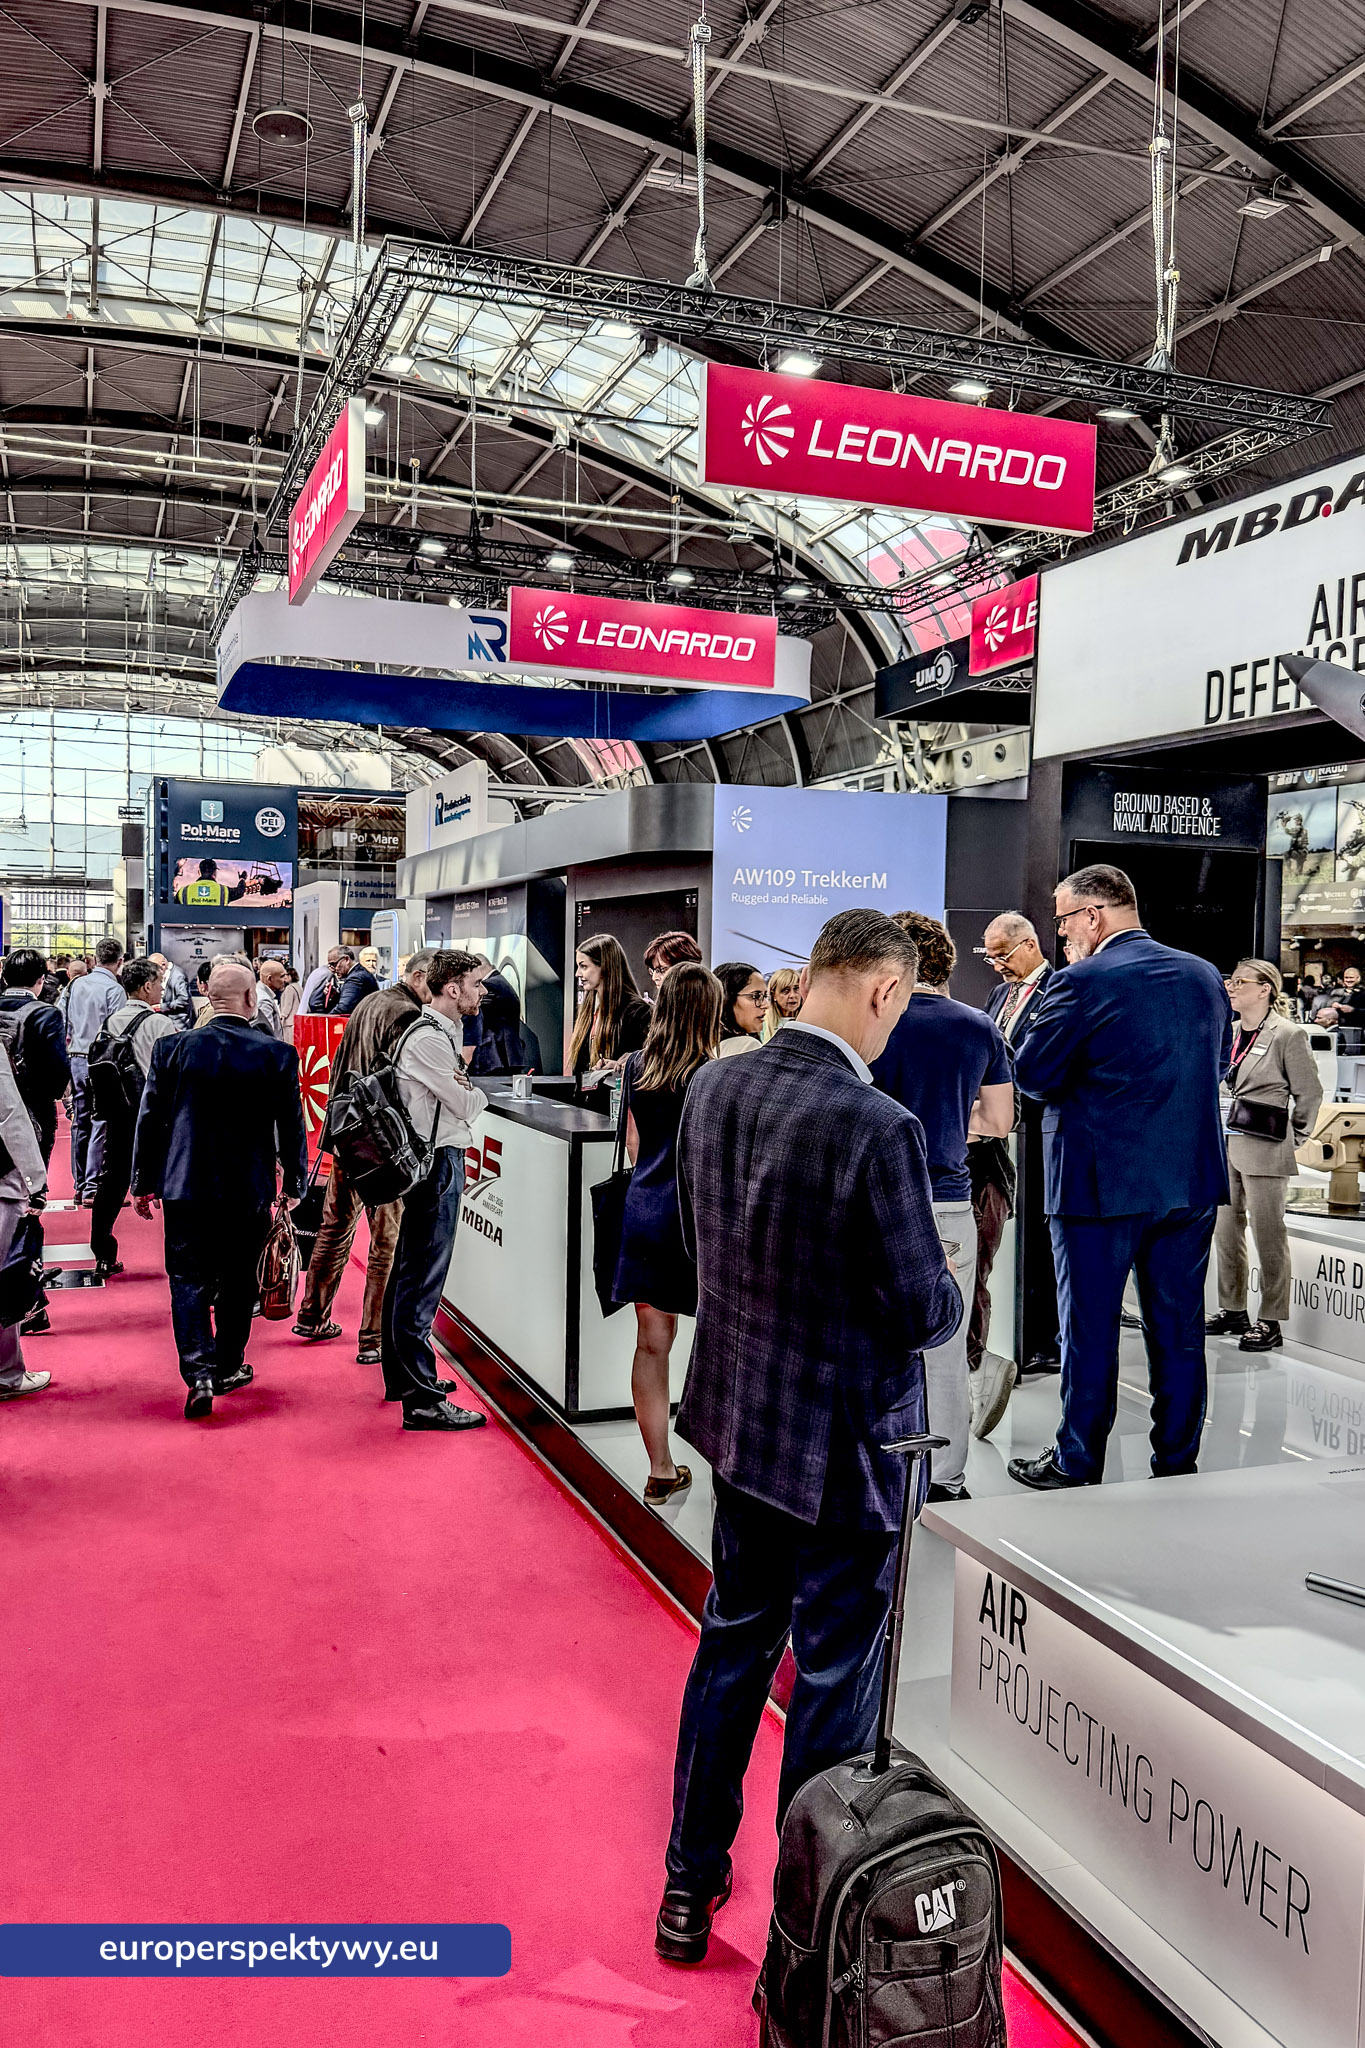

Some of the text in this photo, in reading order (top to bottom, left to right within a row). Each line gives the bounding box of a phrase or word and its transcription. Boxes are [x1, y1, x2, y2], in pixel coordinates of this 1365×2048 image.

[807, 419, 1067, 490] LEONARDO
[299, 448, 343, 553] LEONARDO
[1306, 571, 1365, 646] AIR
[576, 619, 756, 661] LEONARDO
[1204, 636, 1365, 725] DEFEE
[261, 818, 279, 826] PEI
[1113, 792, 1213, 817] GROUND BASED &
[181, 823, 240, 838] Pol-Mare
[350, 832, 399, 845] PolMare
[1113, 812, 1221, 837] NAVAL AIR DEFENCE
[732, 867, 888, 889] AW109 TrekkerM
[731, 893, 829, 905] Rugged and Reliable
[462, 1205, 503, 1248] MBDA
[1316, 1254, 1346, 1287] AIR
[1325, 1286, 1365, 1324] YOUR
[979, 1572, 1027, 1655] AIR
[979, 1635, 1311, 1956] PROJECTING POWER
